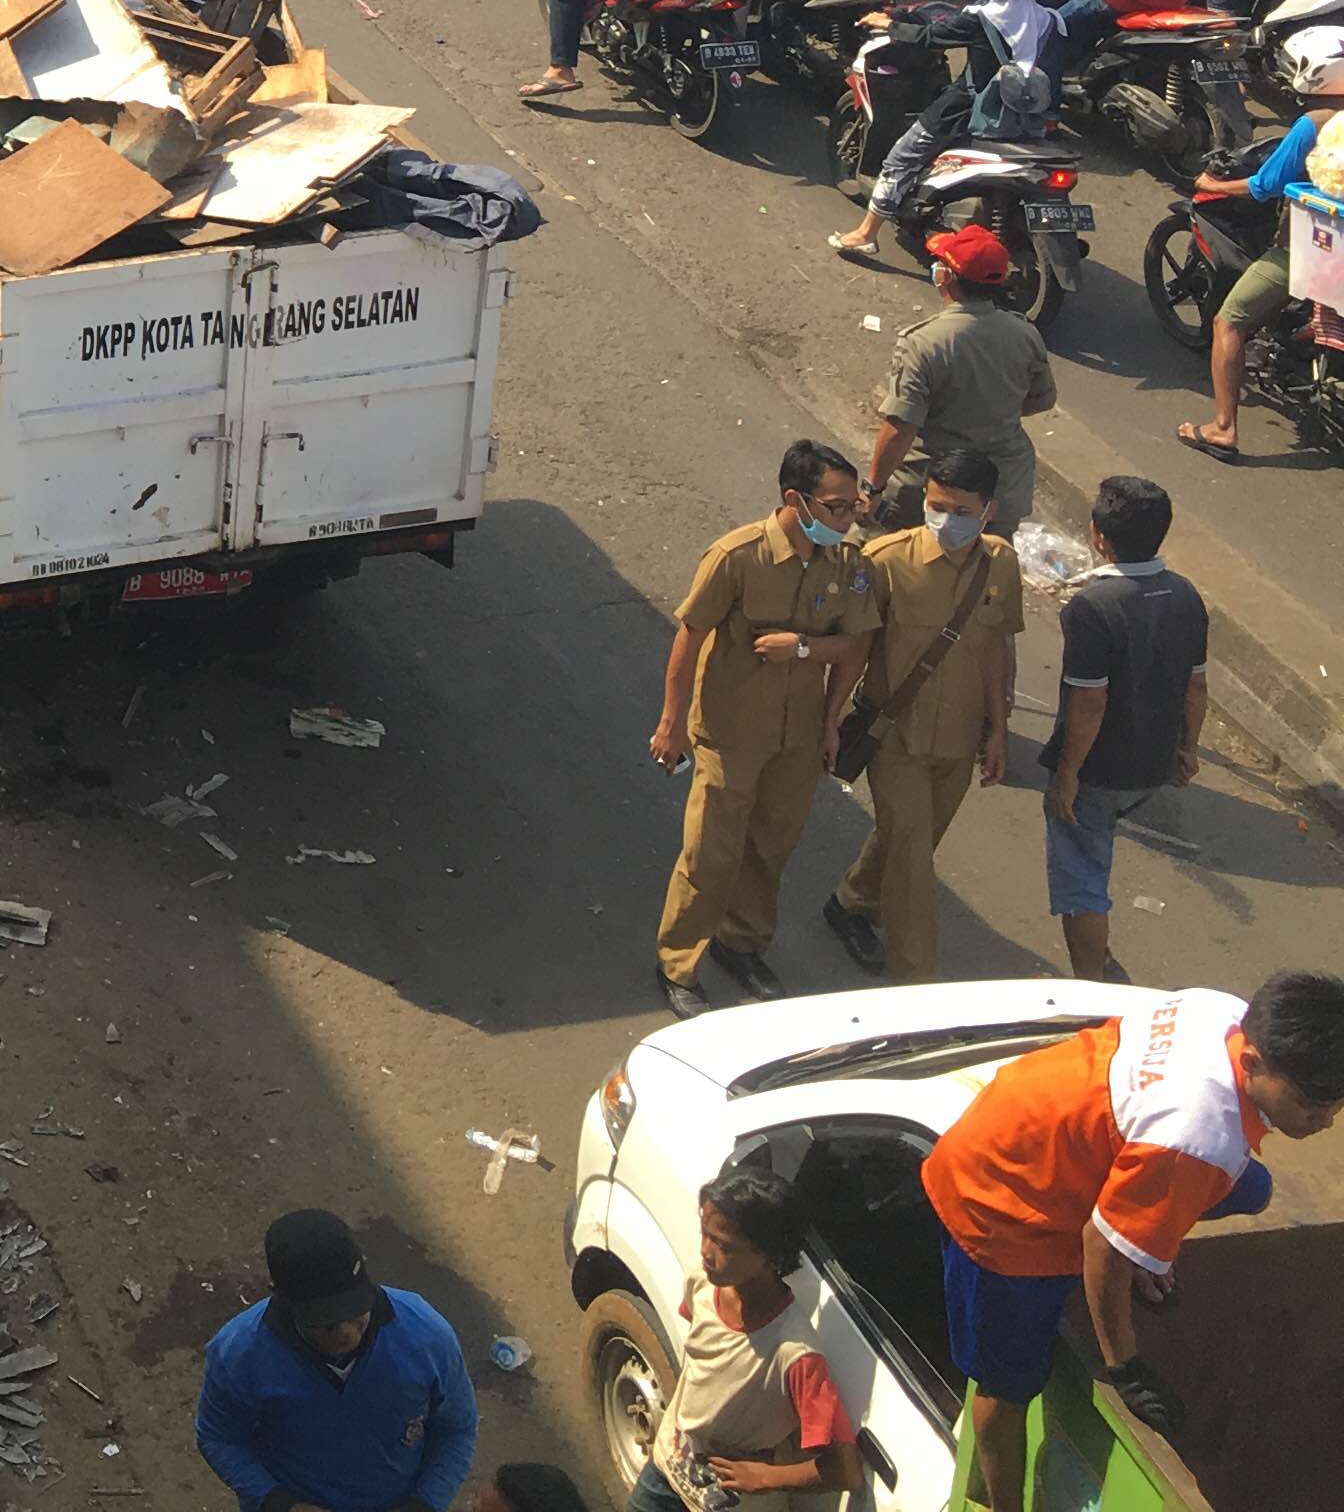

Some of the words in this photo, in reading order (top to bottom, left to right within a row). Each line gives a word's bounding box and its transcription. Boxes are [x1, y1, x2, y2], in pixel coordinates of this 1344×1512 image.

[81, 323, 135, 361] DKPP
[141, 315, 195, 356] KOTA
[330, 287, 420, 333] SELATAN
[129, 574, 142, 591] B
